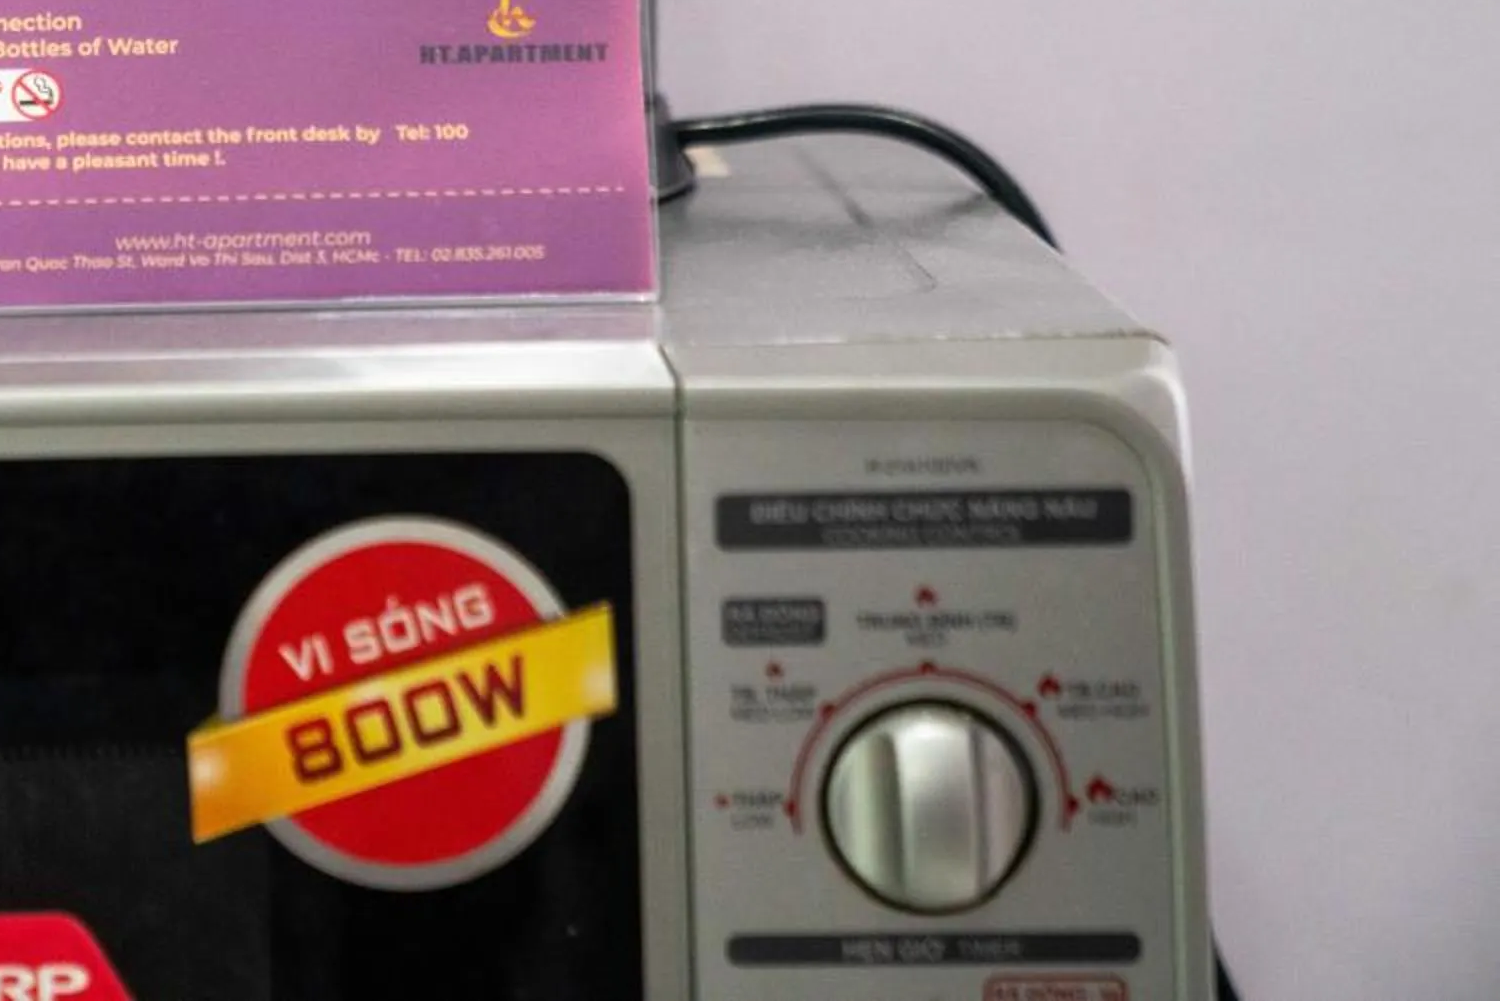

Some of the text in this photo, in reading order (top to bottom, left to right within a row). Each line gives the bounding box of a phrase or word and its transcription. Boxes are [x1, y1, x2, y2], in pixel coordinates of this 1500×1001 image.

[78, 38, 102, 56] of
[108, 37, 178, 56] Water
[419, 43, 609, 65] HT.APARTMENT
[56, 128, 122, 149] please
[127, 126, 204, 146] contact
[207, 125, 241, 144] the
[246, 126, 298, 143] front
[302, 124, 350, 143] desk
[356, 125, 381, 145] by
[396, 125, 430, 141] Tel:
[435, 124, 468, 140] 100
[3, 153, 50, 171] have
[55, 157, 68, 170] a
[72, 152, 157, 173] pleasant
[163, 150, 209, 168] time
[214, 251, 238, 265] Thi
[278, 583, 496, 682] VI SÓNG
[286, 654, 527, 785] 800W
